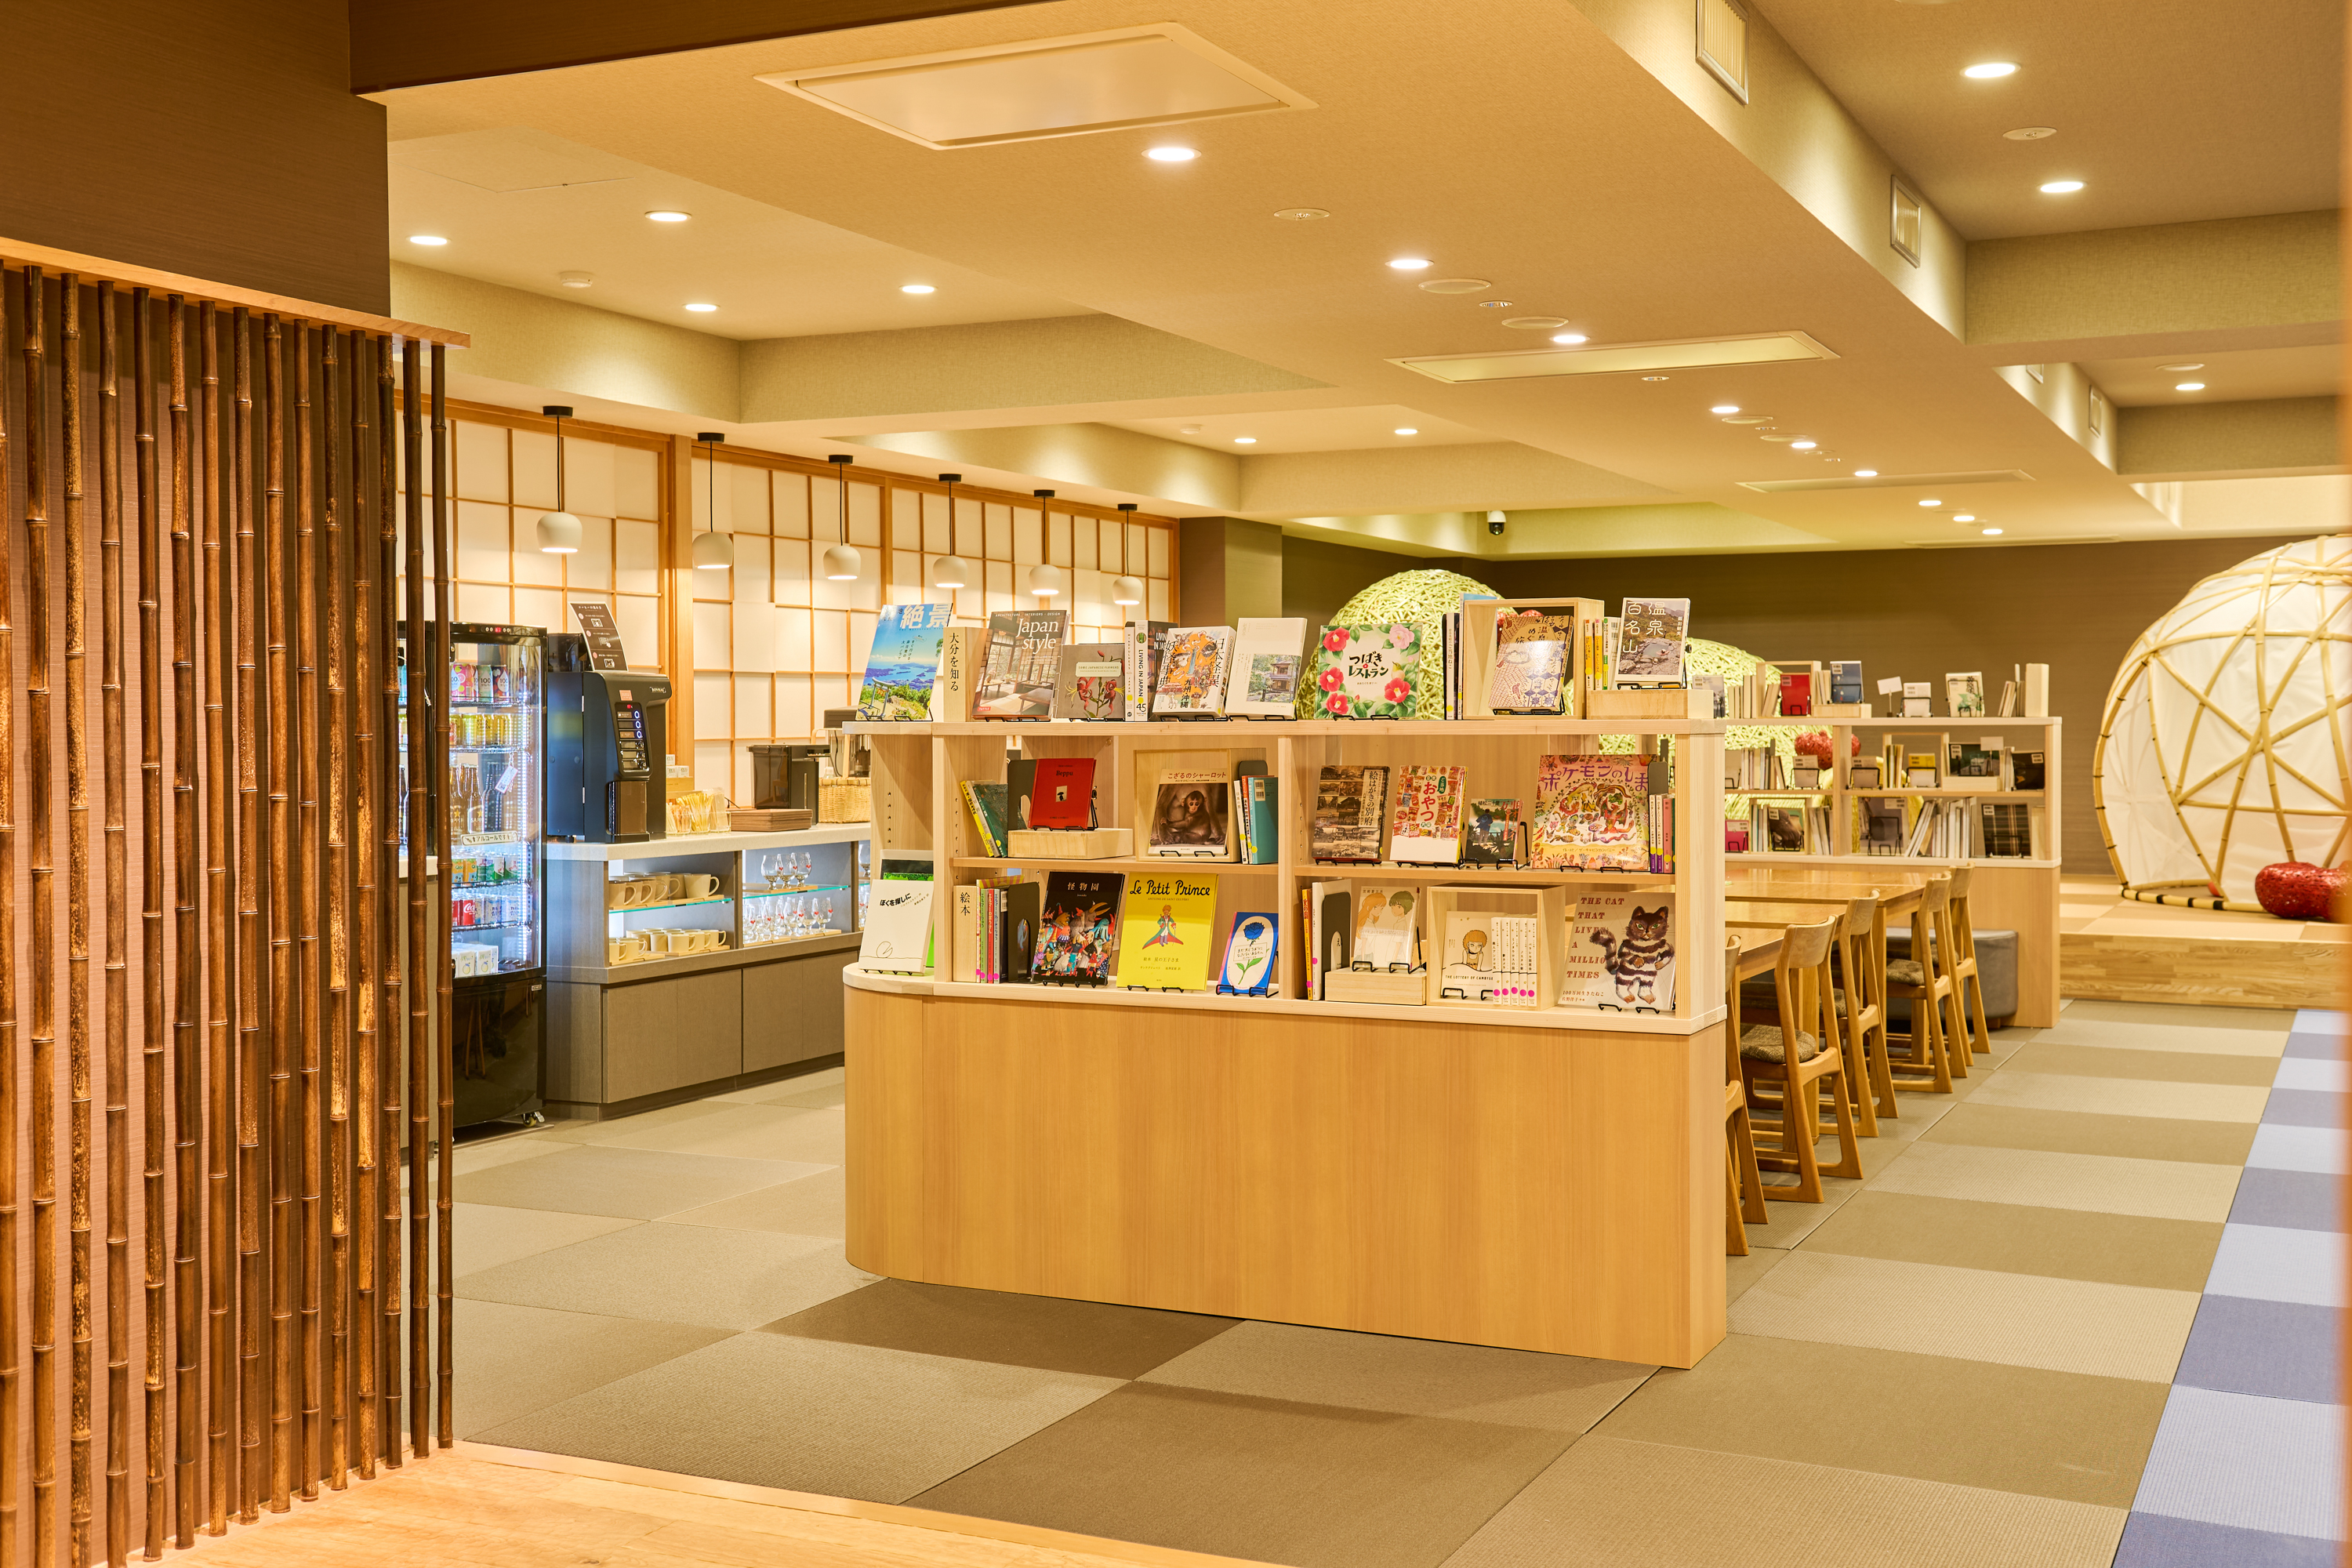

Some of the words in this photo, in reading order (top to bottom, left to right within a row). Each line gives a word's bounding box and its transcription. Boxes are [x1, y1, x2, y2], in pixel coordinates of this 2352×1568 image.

[899, 604, 951, 629] 絶景
[1016, 618, 1059, 638] Japan
[1623, 601, 1642, 653] 百名山
[1646, 601, 1667, 636] 温泉
[1022, 633, 1057, 655] style
[1156, 632, 1167, 641] LIVIN
[949, 633, 960, 691] 大分を知る
[1348, 651, 1382, 666] つばき
[1348, 665, 1388, 679] レストラン
[1544, 765, 1648, 792] ポケモンのしま
[1364, 771, 1379, 826] 絵はがきの別府
[1420, 782, 1437, 821] おやつ
[1067, 882, 1099, 891] 怪物園
[1130, 880, 1142, 895] Le
[1146, 880, 1171, 895] Petit
[1175, 880, 1210, 896] Prince
[880, 893, 912, 906] ぼくを探しに
[960, 891, 971, 916] 絵本
